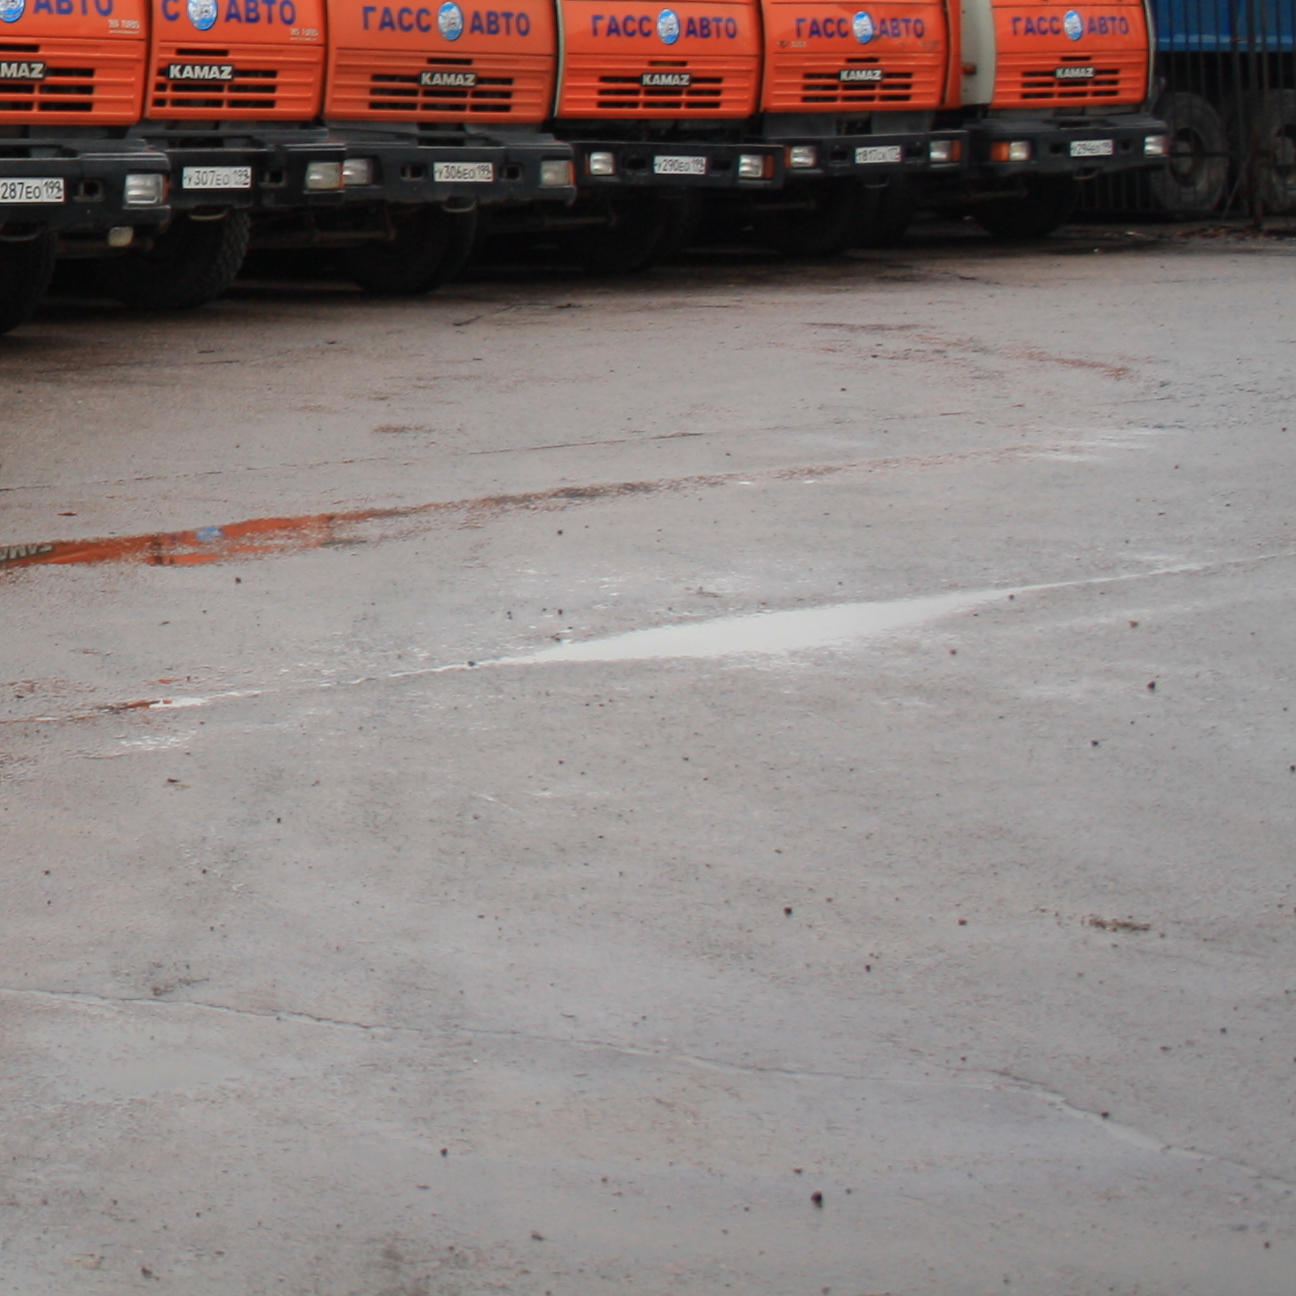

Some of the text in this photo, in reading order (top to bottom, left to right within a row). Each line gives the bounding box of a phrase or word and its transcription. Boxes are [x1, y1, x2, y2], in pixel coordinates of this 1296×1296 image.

[362, 6, 530, 36] ГАСС АВТО
[592, 15, 737, 39] ГАСС АВТО
[795, 18, 925, 38] ГАСС АВТО
[1012, 17, 1129, 36] ГАСС АВТО
[169, 64, 233, 79] KAMAZ
[420, 72, 476, 86] KAMAZ
[840, 70, 882, 81] KAMAZ
[1056, 67, 1094, 78] KAMAZ
[642, 74, 690, 86] KAMAZ
